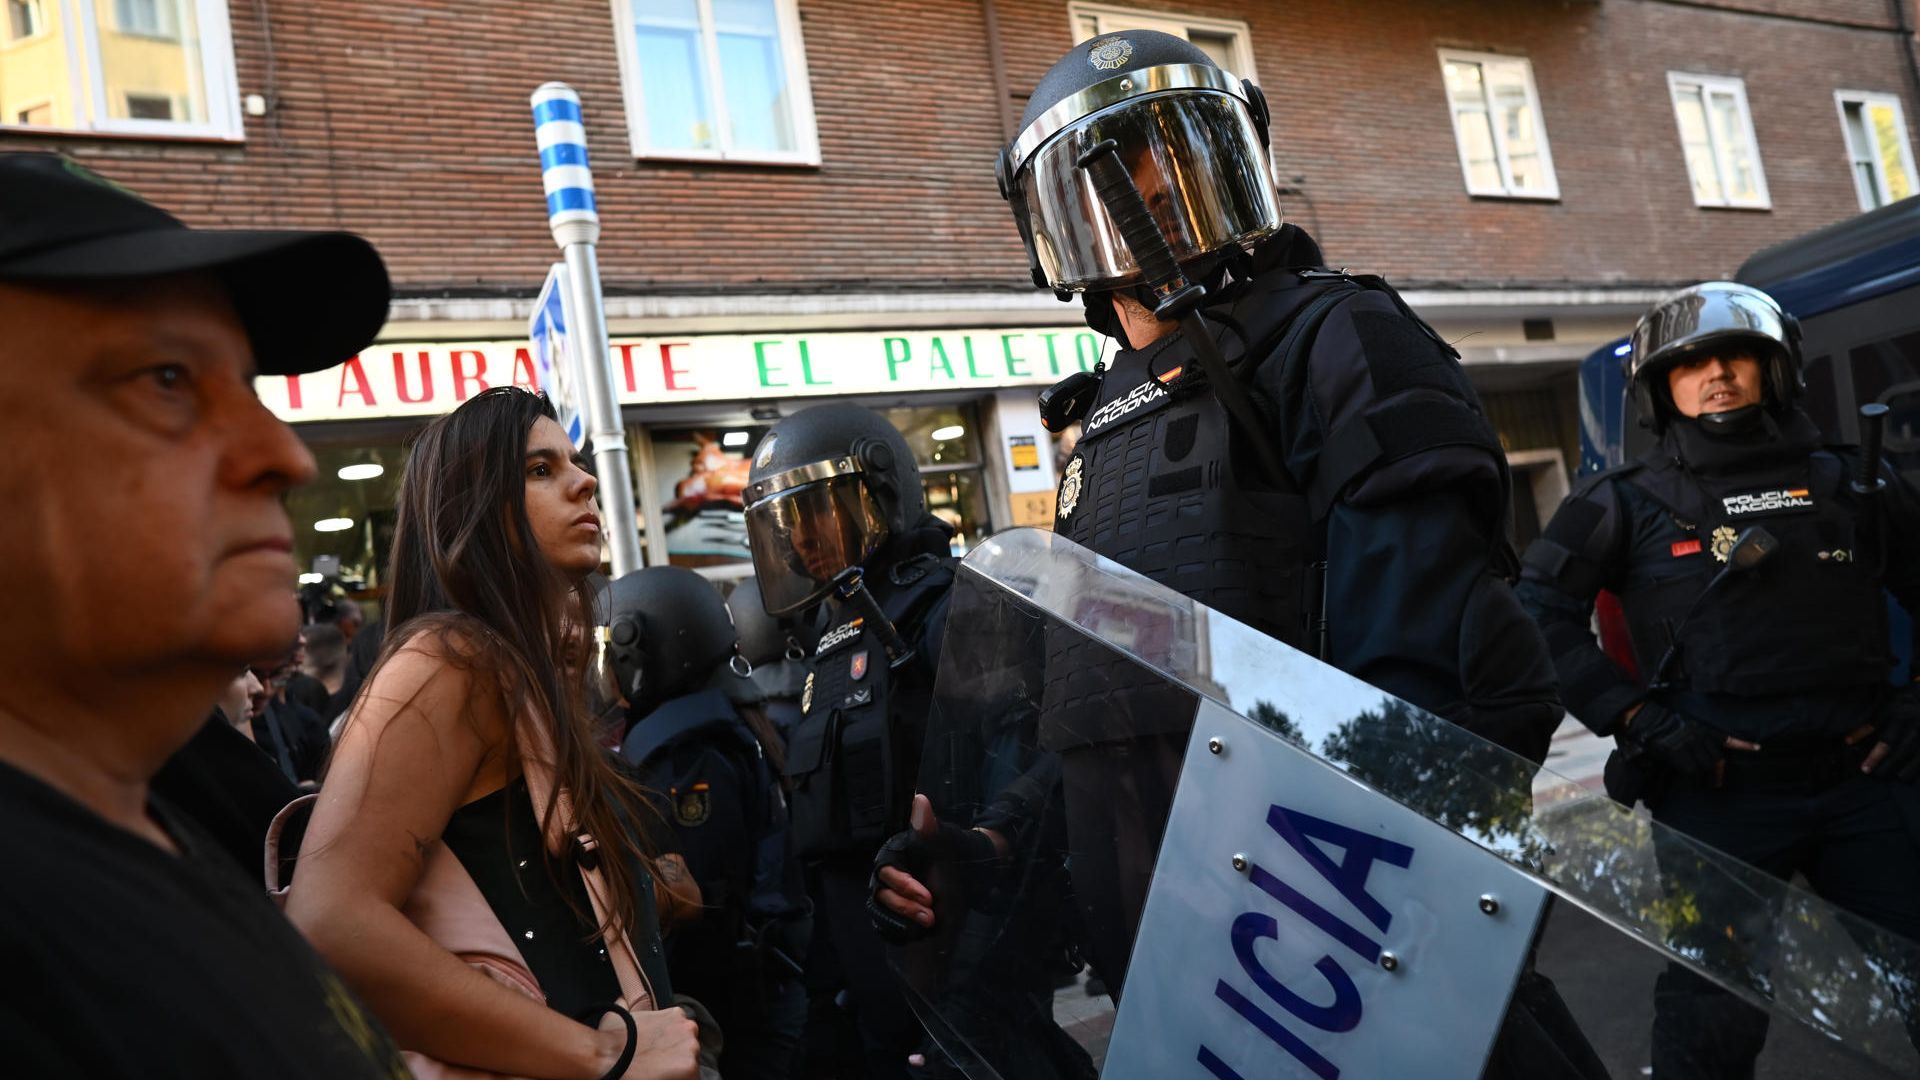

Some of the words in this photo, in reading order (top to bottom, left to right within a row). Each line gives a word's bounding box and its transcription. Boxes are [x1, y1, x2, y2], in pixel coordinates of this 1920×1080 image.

[286, 342, 697, 409] AURATE
[754, 340, 833, 388] EL
[883, 332, 1101, 381] PALETO
[1086, 387, 1168, 433] NACIONA
[1723, 490, 1793, 507] POLICIA
[1726, 497, 1813, 515] NACIONAL
